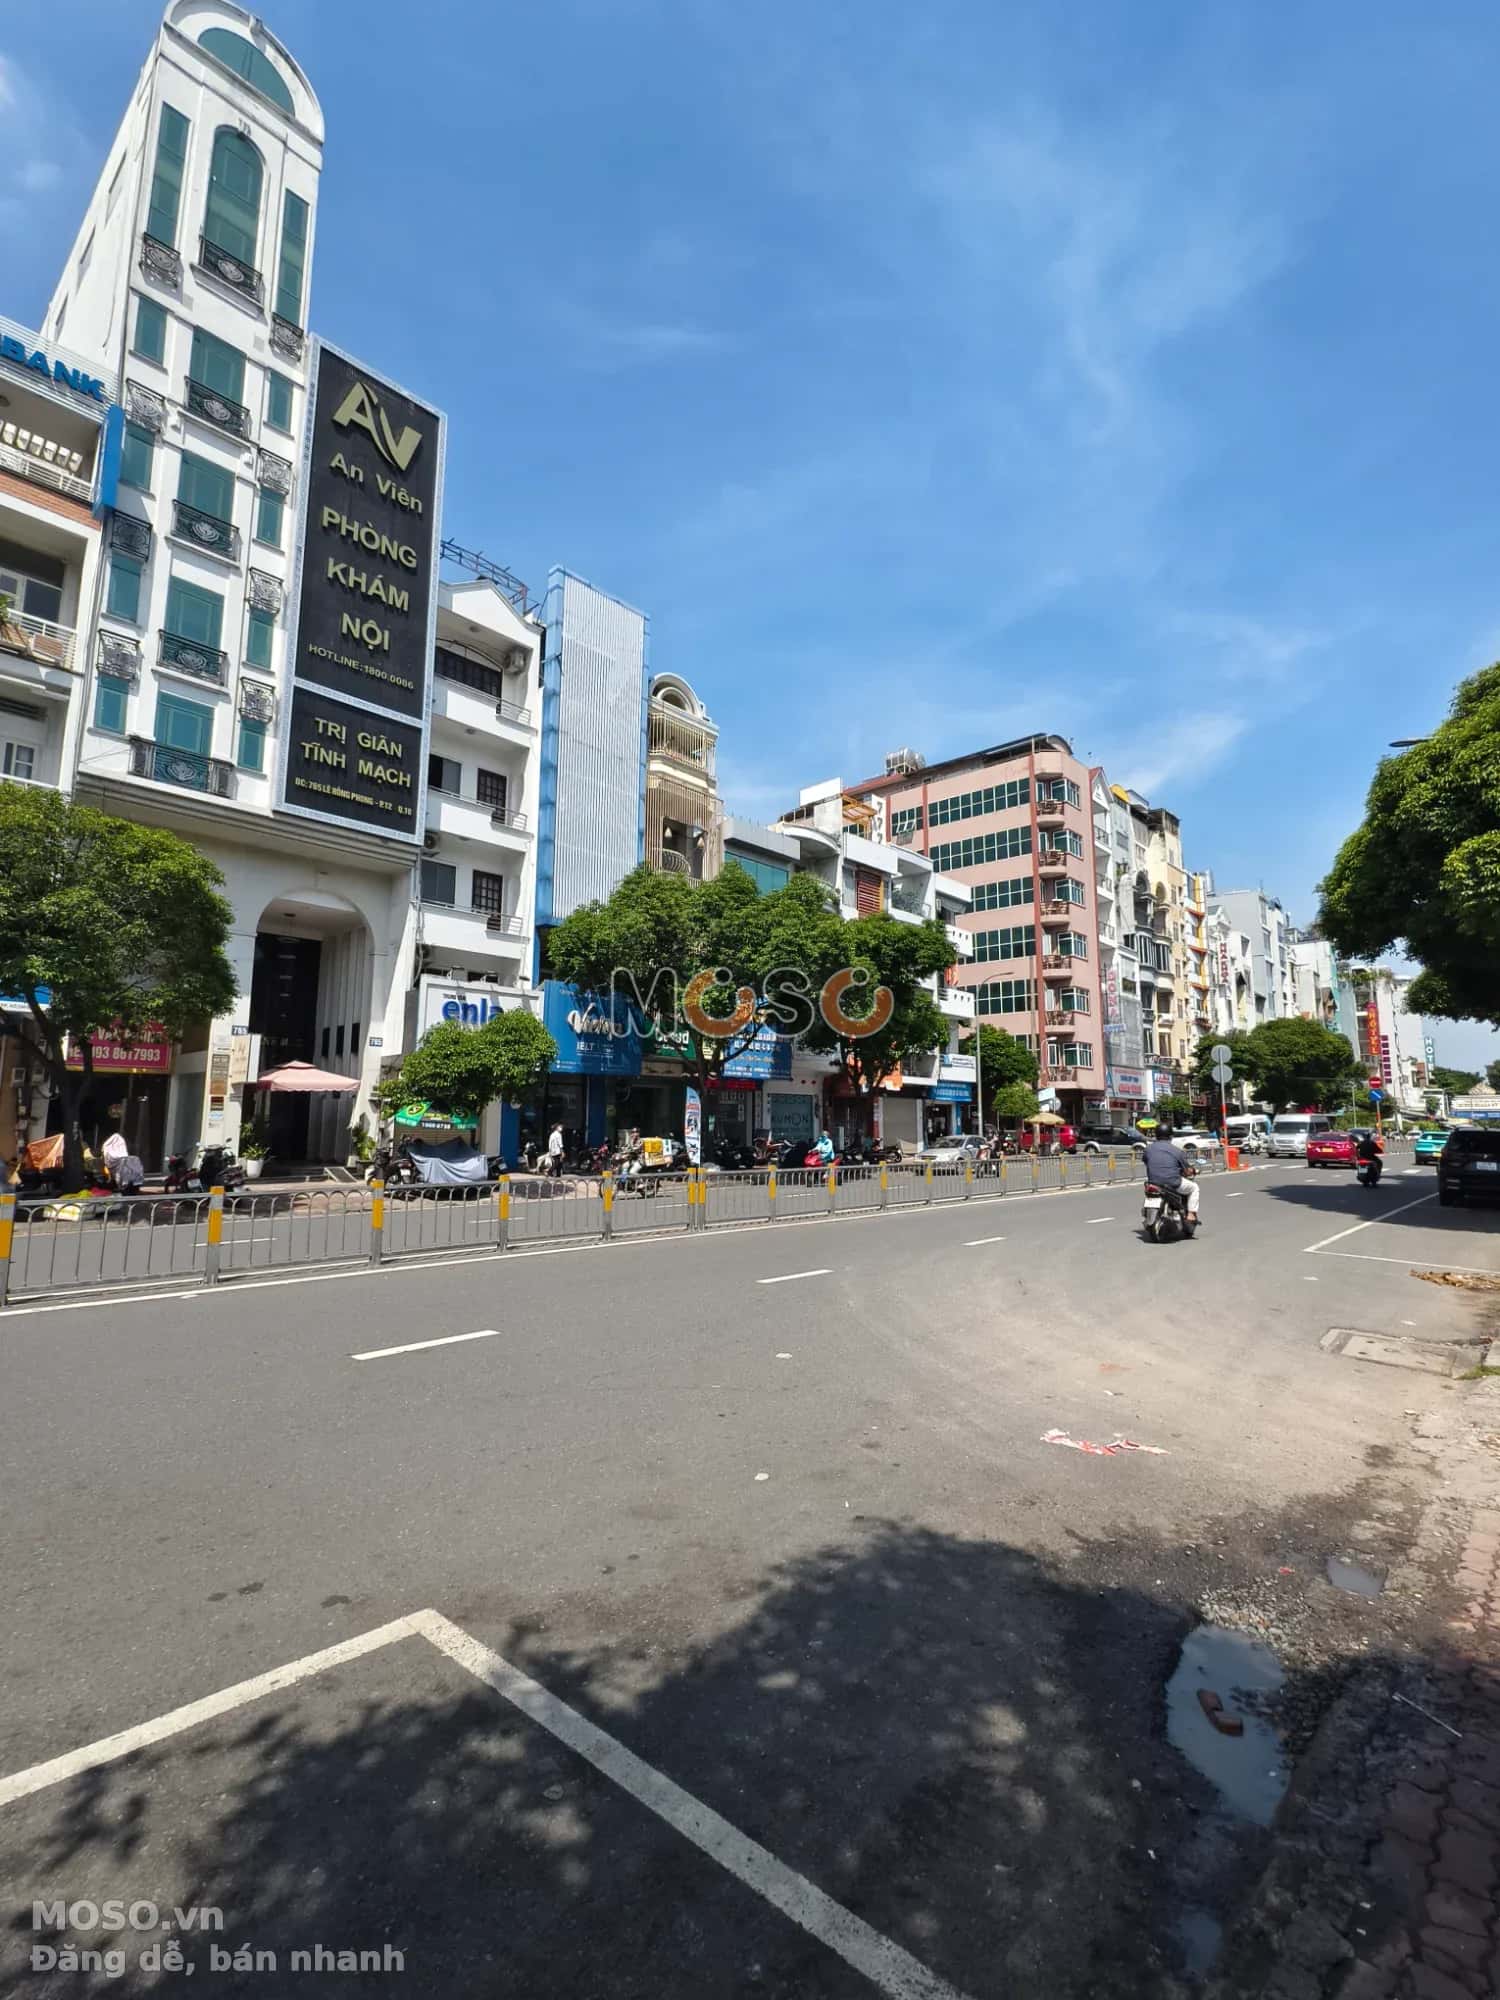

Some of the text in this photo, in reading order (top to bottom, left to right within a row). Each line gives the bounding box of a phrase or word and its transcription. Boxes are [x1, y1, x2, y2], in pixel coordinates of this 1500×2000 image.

[331, 381, 422, 471] AV
[330, 453, 423, 513] An Viên
[322, 506, 418, 568] PHÒNG
[328, 557, 409, 612] KHÁM
[341, 612, 389, 651] NỘI
[301, 741, 412, 788] TĨNH MẠCH
[315, 717, 403, 758] TRỊ GIÃN
